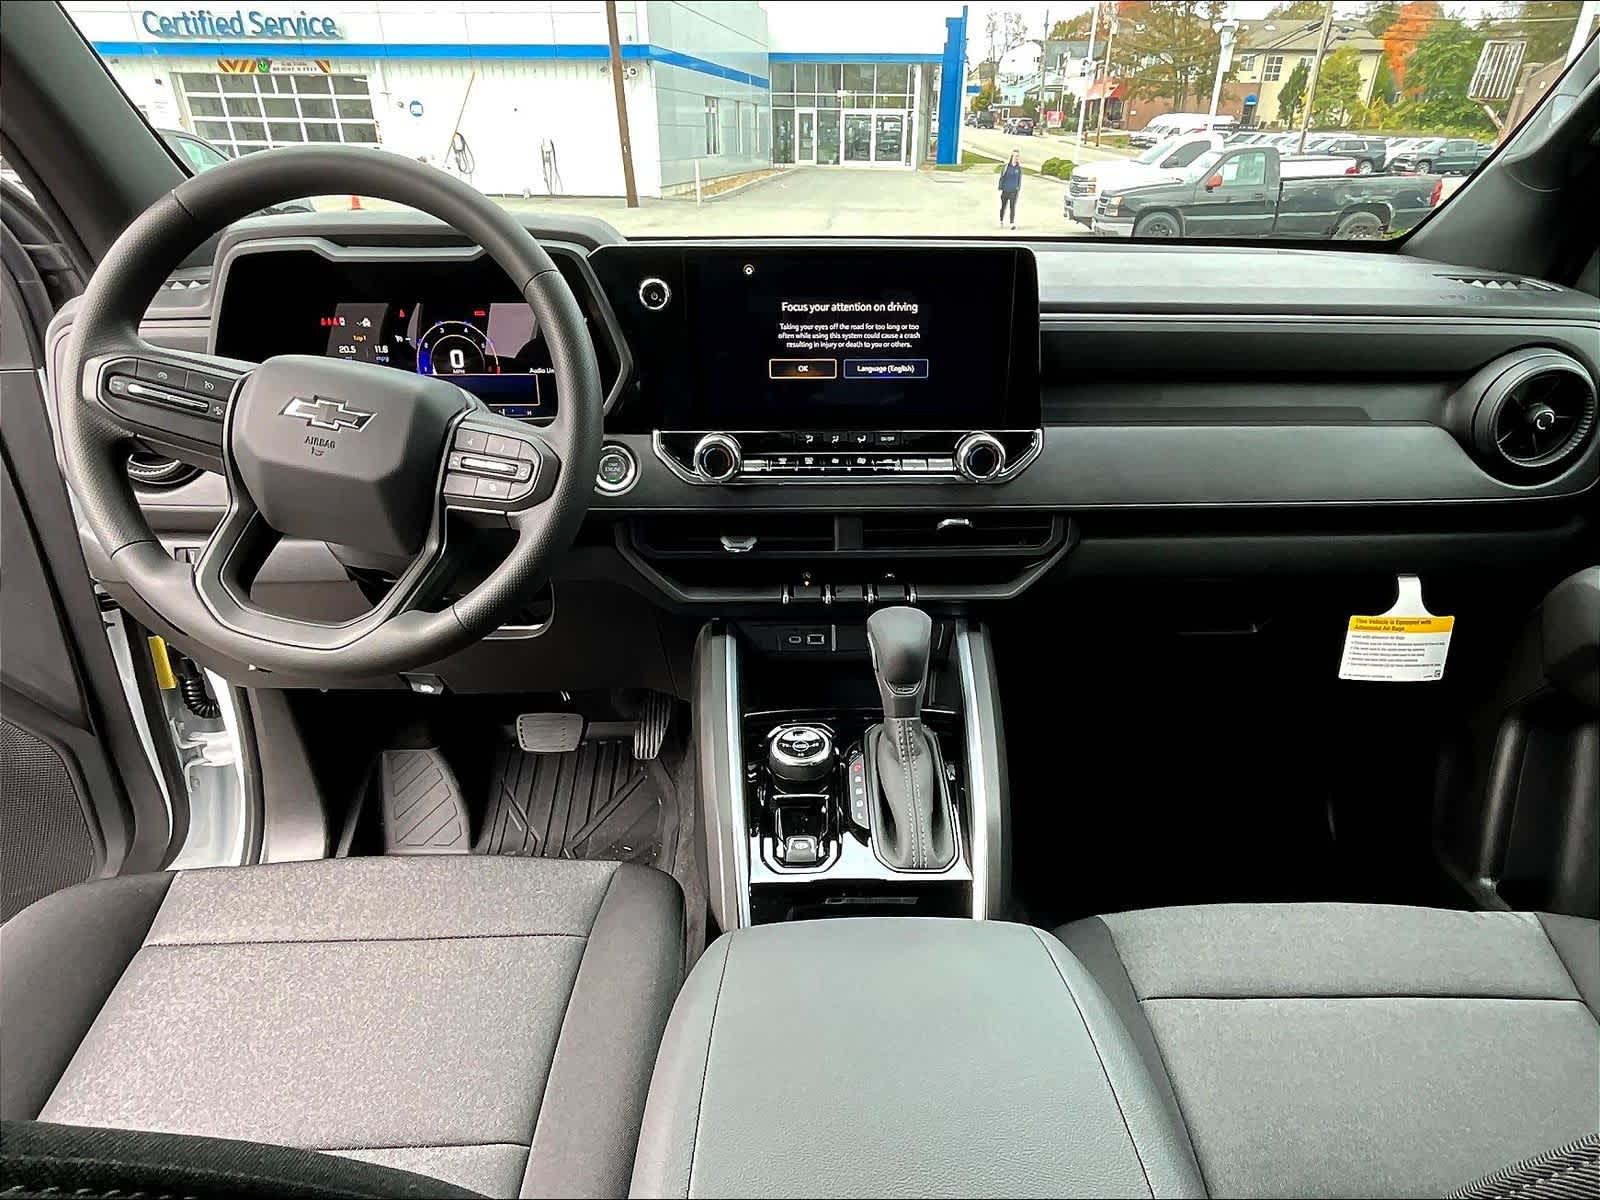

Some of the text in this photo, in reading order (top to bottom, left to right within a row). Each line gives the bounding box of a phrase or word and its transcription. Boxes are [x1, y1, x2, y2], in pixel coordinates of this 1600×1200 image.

[142, 10, 337, 37] Certified Service
[781, 302, 918, 313] Focus your attention on driving
[779, 323, 799, 331] Taking
[886, 323, 900, 331] long
[812, 332, 829, 340] using
[338, 345, 356, 354] 20.5
[786, 341, 812, 349] resulting
[820, 341, 837, 349] injury
[449, 349, 465, 369] 0
[857, 365, 915, 374] Language (English)
[304, 435, 336, 449] AIRBAG
